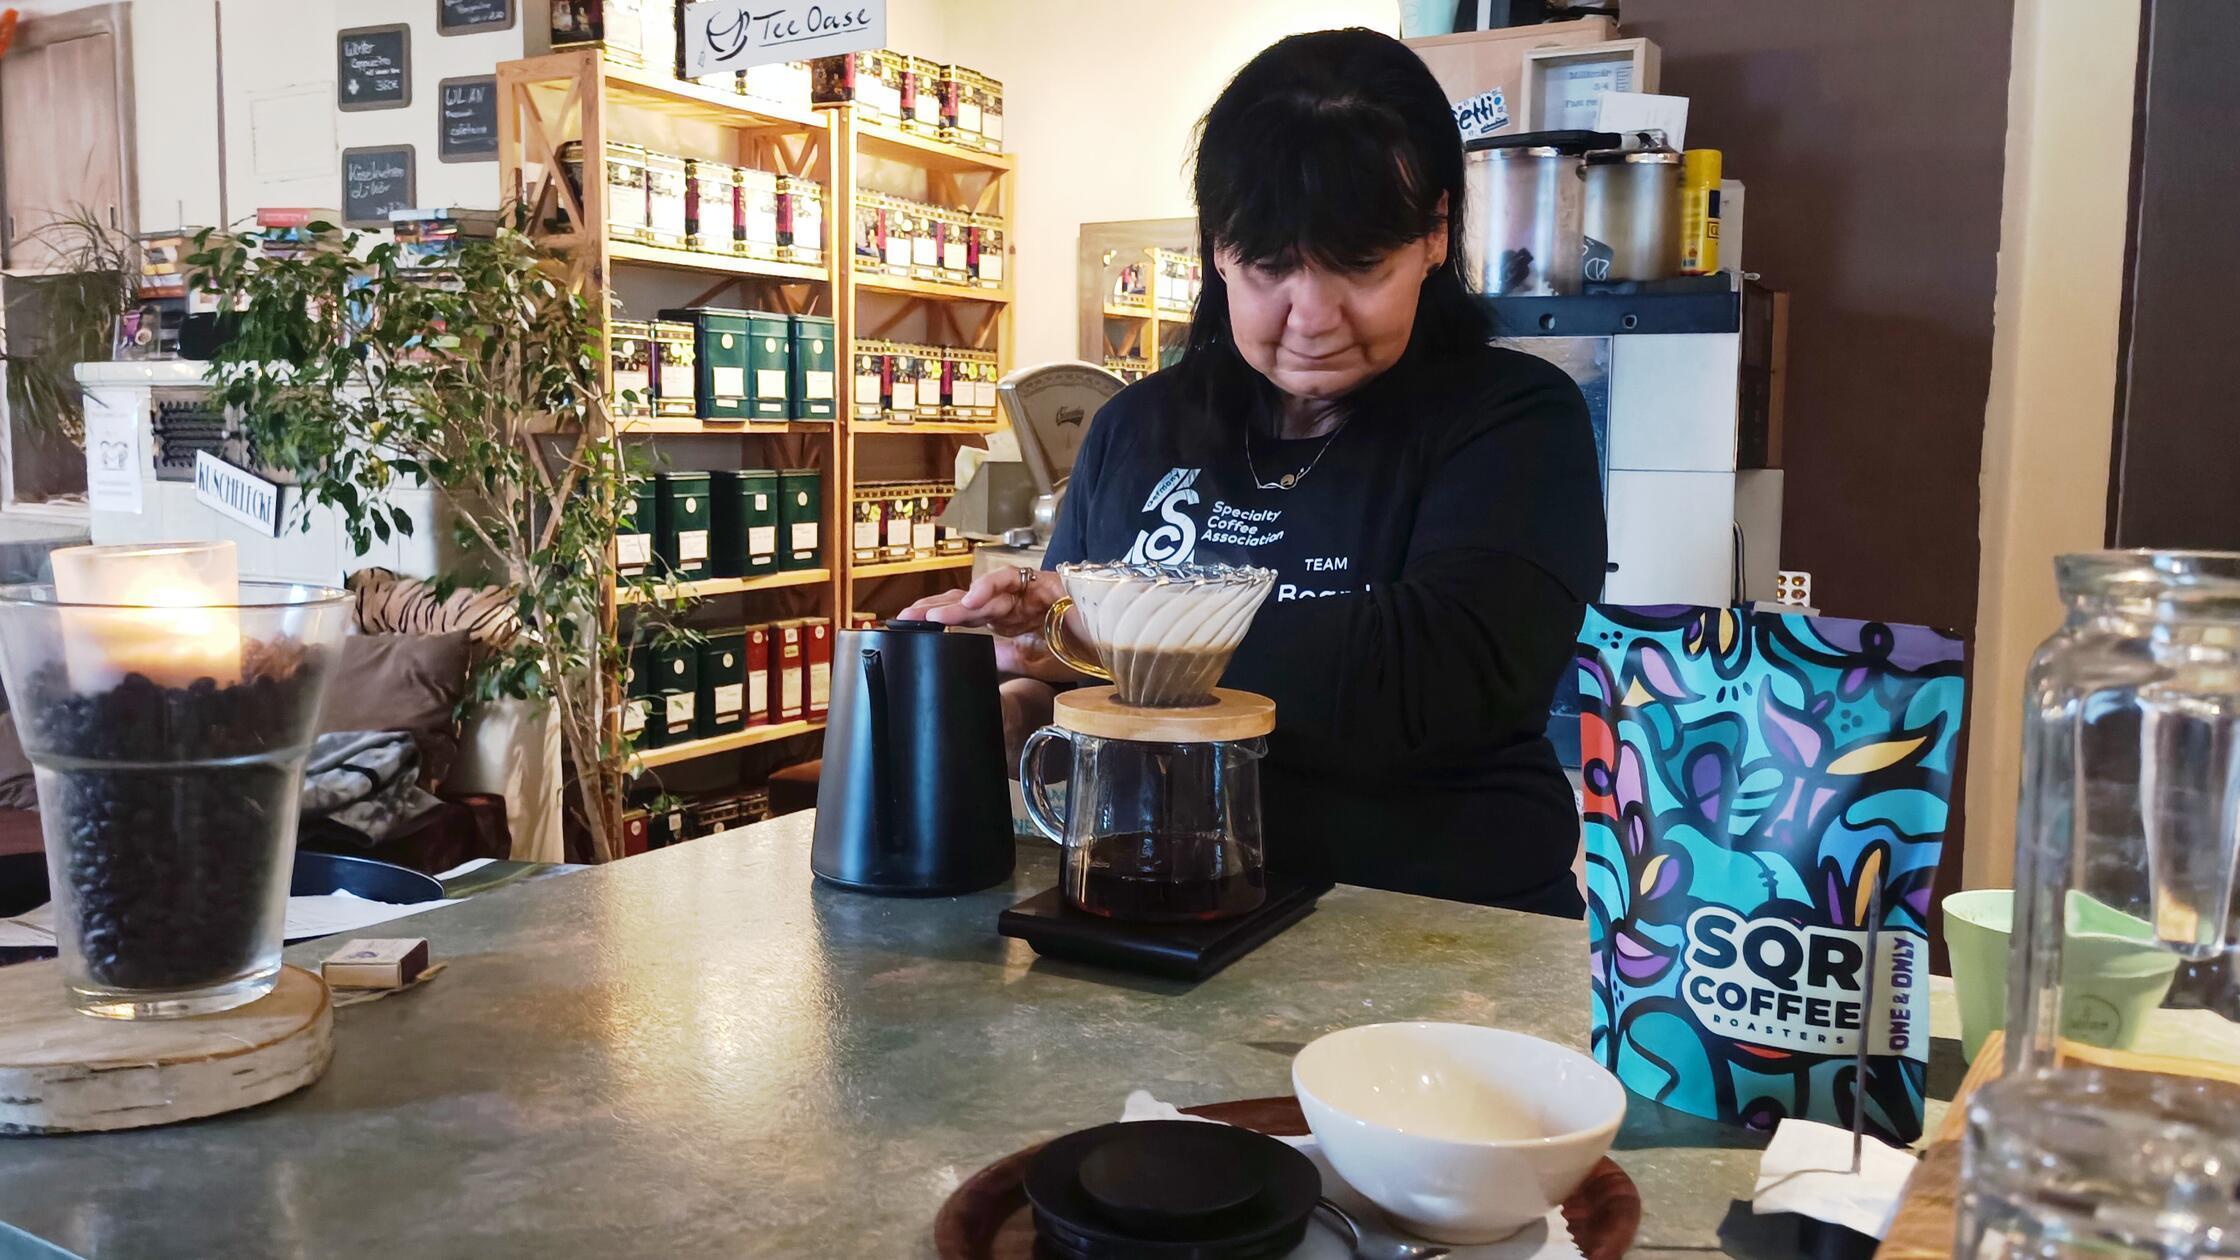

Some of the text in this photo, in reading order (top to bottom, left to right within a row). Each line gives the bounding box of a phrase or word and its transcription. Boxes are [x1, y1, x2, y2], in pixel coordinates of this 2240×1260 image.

[753, 6, 872, 40] Tee Oase
[198, 461, 272, 526] KUSCHELECKE
[1207, 515, 1258, 536] Coffee
[1212, 501, 1282, 524] Specialty
[1200, 529, 1285, 547] Association
[1304, 557, 1348, 571] TEAM
[1692, 914, 1863, 991] SQR
[1690, 975, 1861, 1030] COFFEE
[1889, 937, 1914, 1050] ONE & ONLY
[1713, 1014, 1844, 1044] ROASTERS
